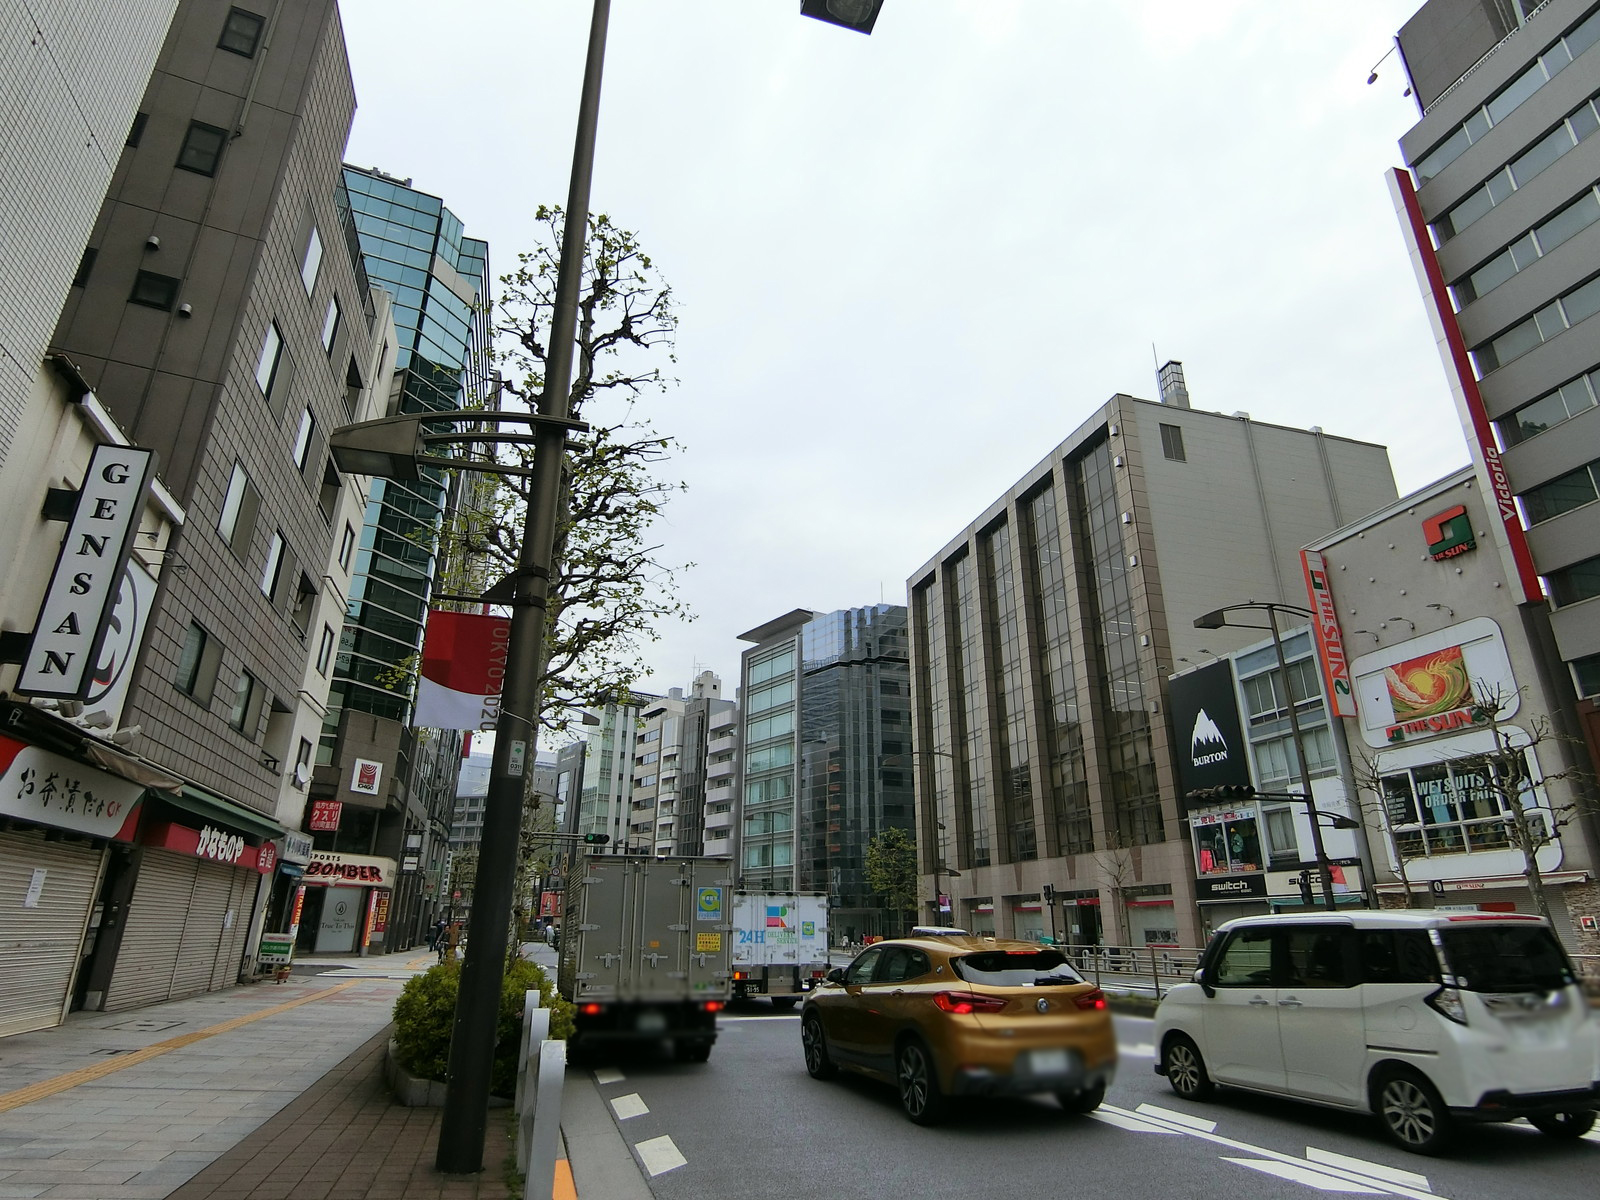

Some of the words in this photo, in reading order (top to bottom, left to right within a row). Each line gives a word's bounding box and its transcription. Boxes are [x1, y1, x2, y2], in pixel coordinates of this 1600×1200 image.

[1486, 446, 1516, 521] Victoria
[37, 462, 131, 677] GENSAN
[1319, 590, 1336, 624] THE
[487, 618, 512, 680] TOKYO
[479, 683, 502, 732] 2020
[1402, 719, 1429, 735] THE
[1193, 750, 1228, 767] BURTON
[357, 783, 374, 791] ICHIGO
[107, 800, 122, 818] OK
[1424, 789, 1467, 809] ORDER
[312, 809, 339, 822] クスリ
[196, 824, 246, 864] かなものや
[310, 853, 341, 862] SPORTS
[305, 861, 383, 882] BOMBER
[1211, 879, 1248, 892] switch
